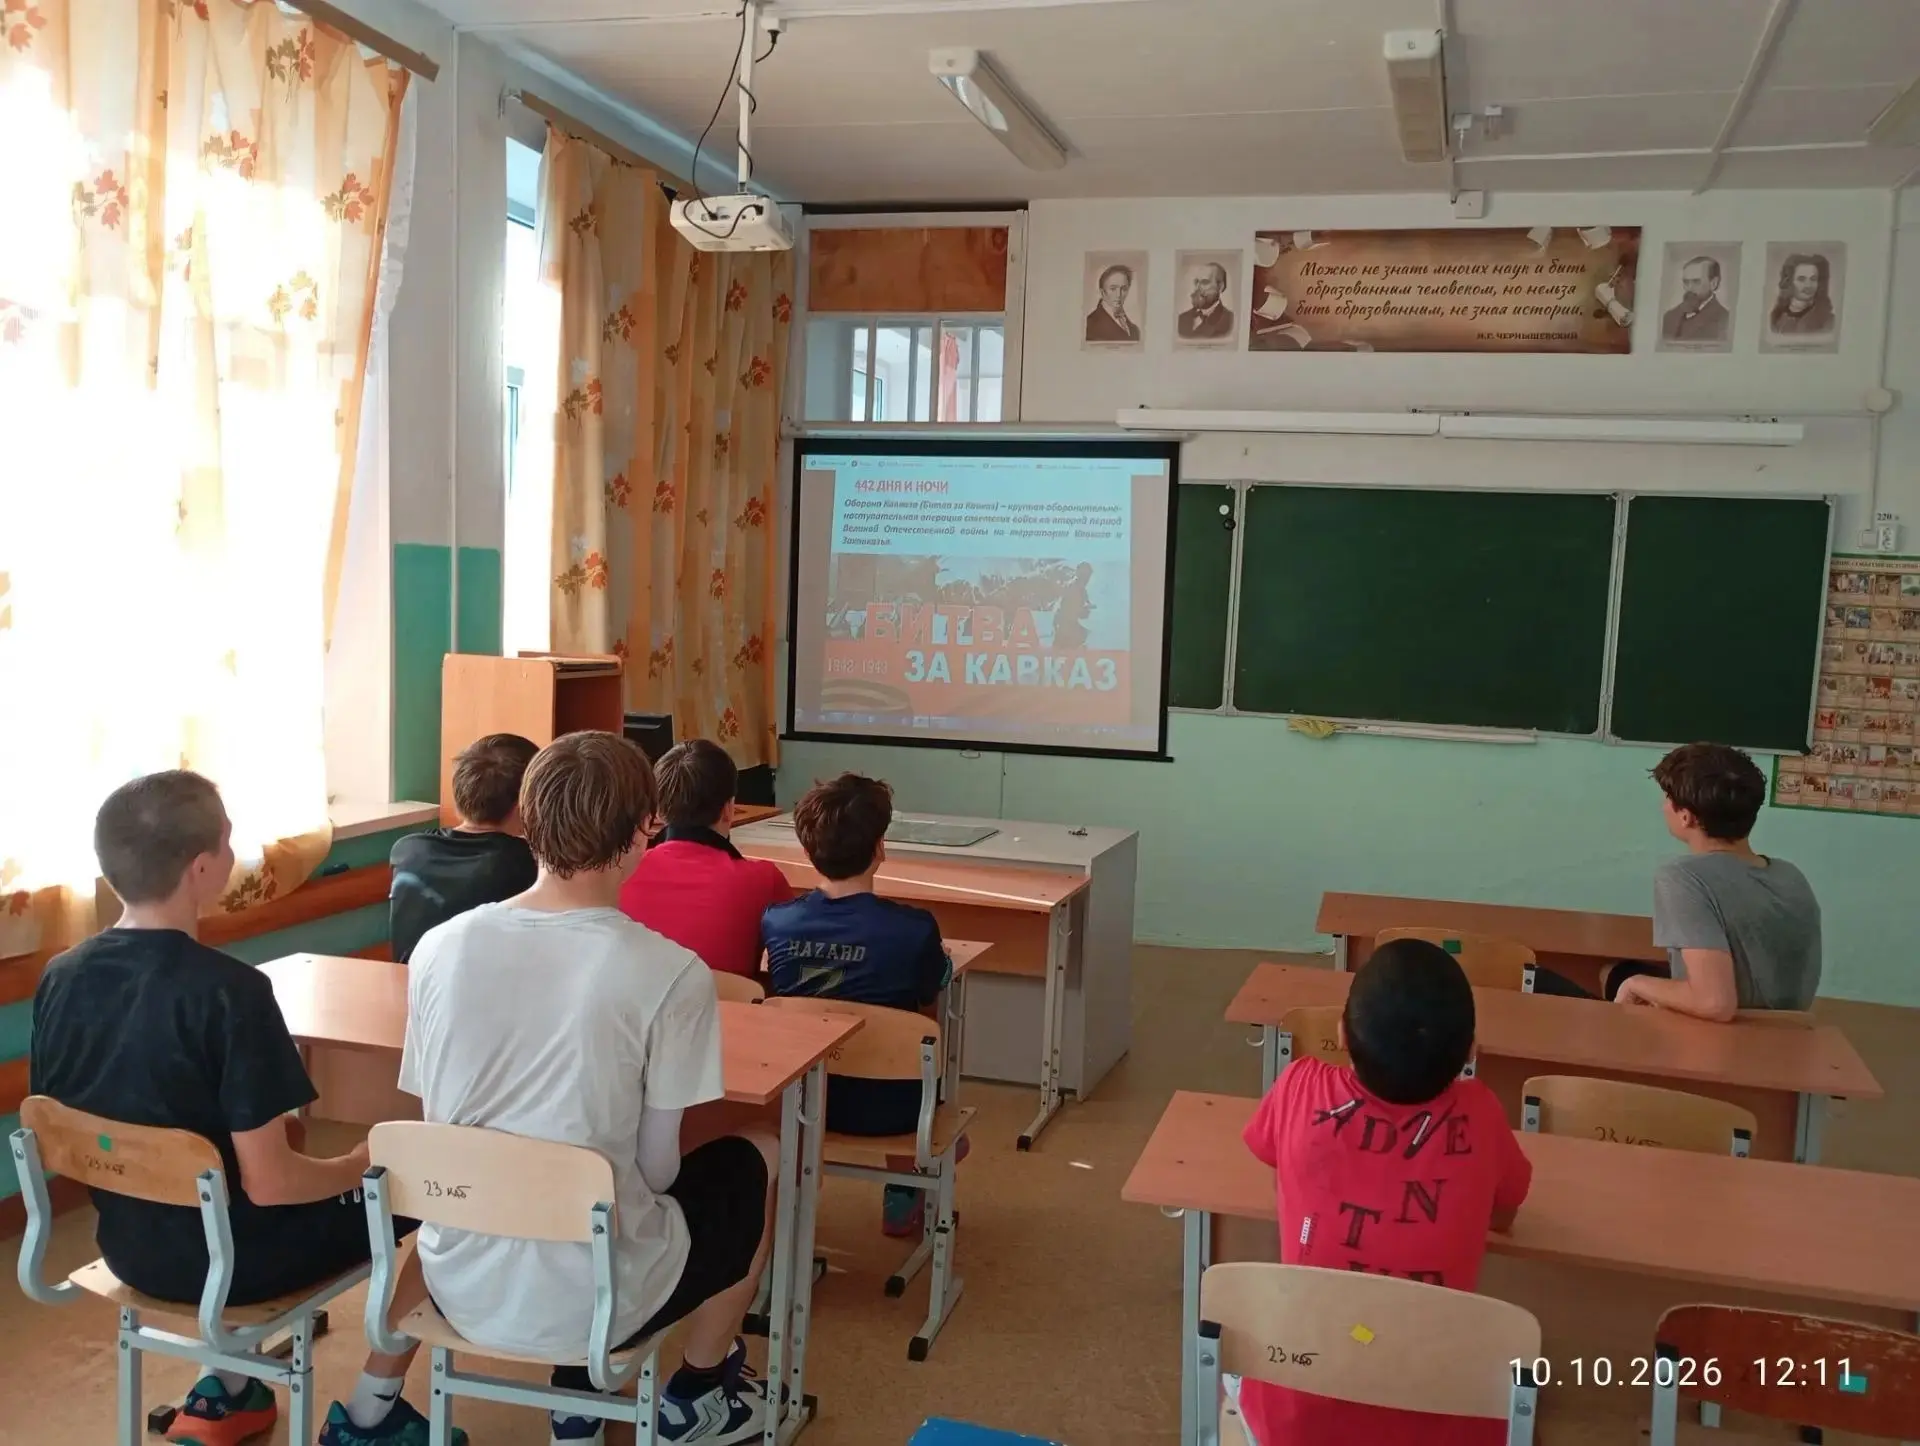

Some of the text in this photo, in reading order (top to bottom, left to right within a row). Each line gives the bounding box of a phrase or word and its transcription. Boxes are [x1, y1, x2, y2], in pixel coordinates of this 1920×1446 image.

[1300, 258, 1587, 280] Можно не знать многих наук и быть
[1306, 280, 1577, 300] образованным человеком, но нельзя
[1295, 300, 1583, 320] быть образованным, не зная истории.
[854, 479, 948, 494] 442 ДНЯ И НОЧИ
[864, 602, 1040, 648] БИТВА
[904, 650, 1117, 691] ЗА КАВКАЗ
[788, 940, 866, 962] HAZARD
[423, 1179, 443, 1197] 23
[1267, 1345, 1287, 1364] 23
